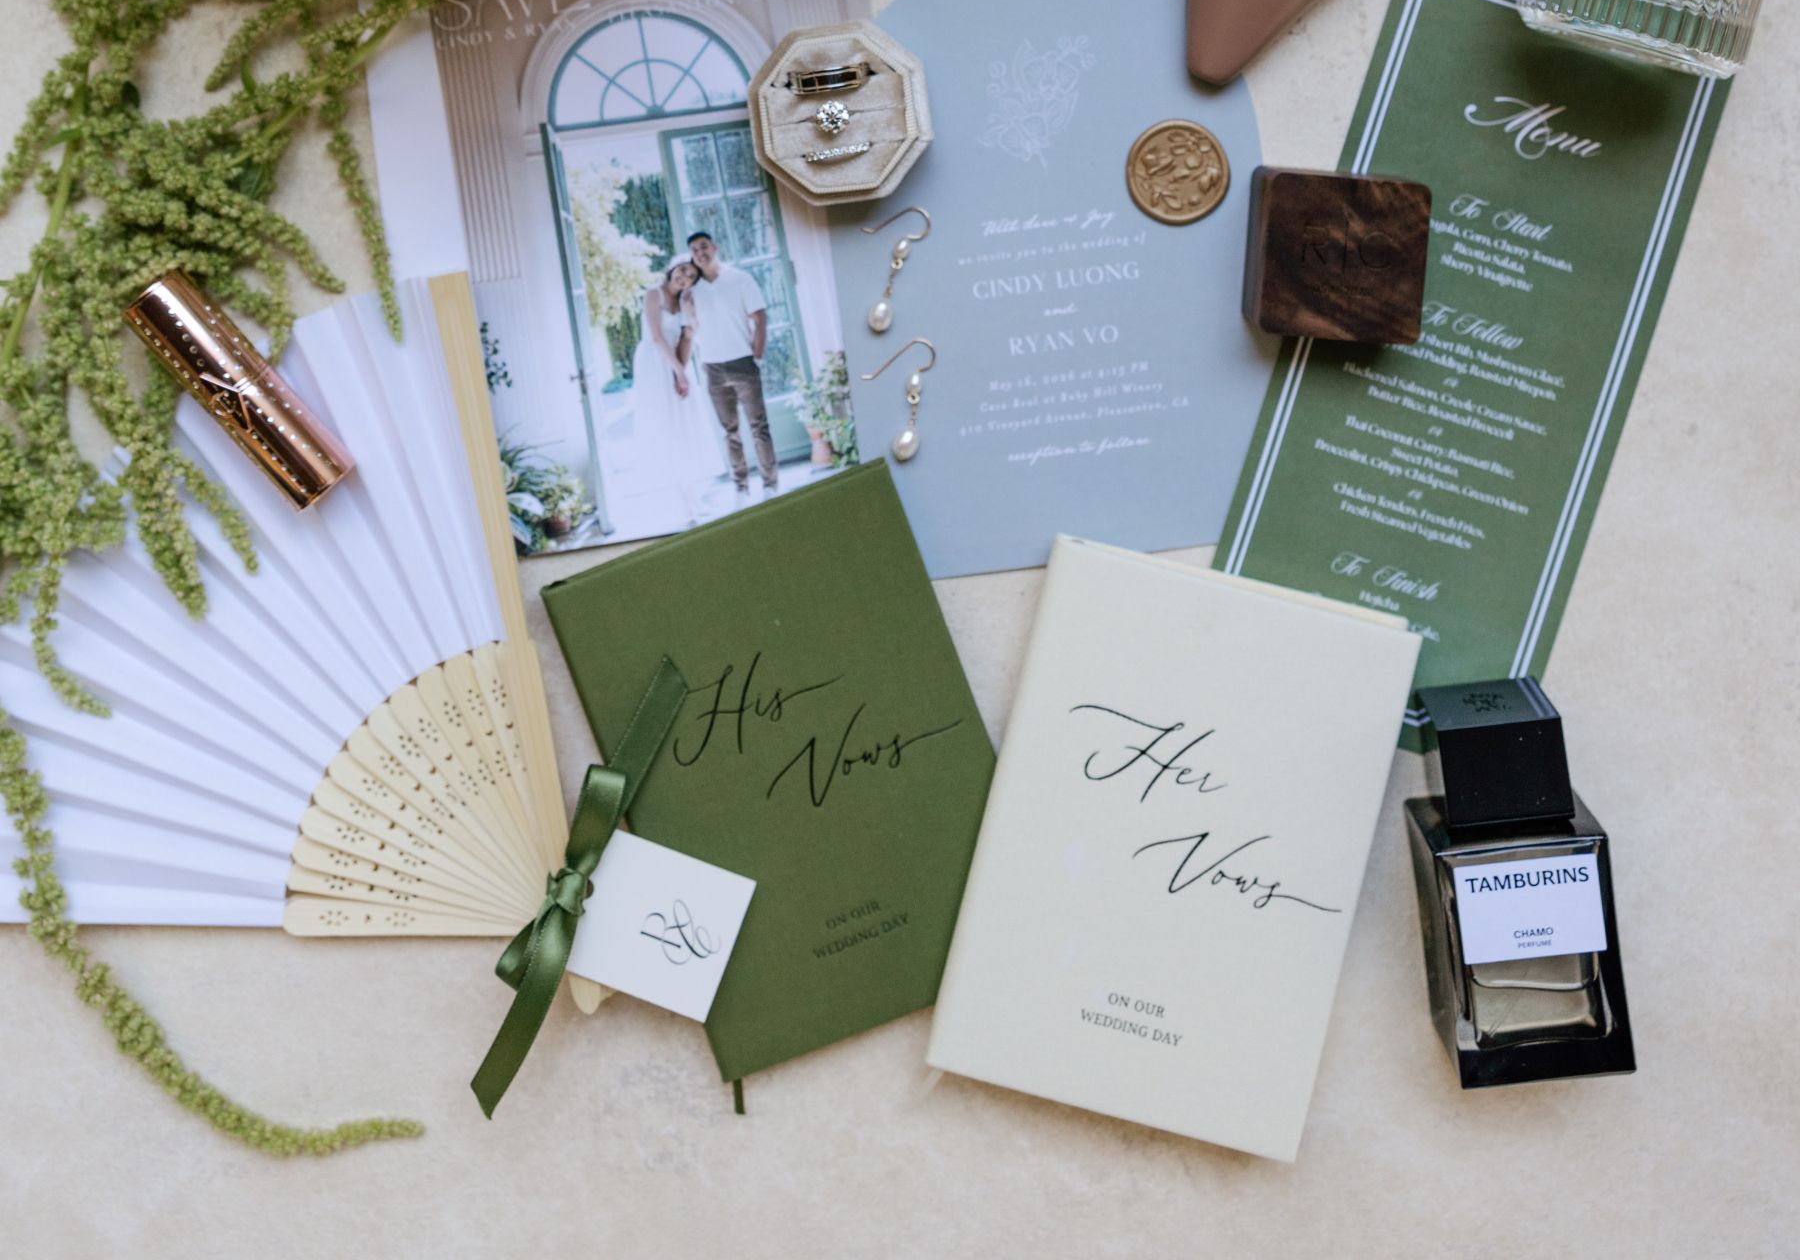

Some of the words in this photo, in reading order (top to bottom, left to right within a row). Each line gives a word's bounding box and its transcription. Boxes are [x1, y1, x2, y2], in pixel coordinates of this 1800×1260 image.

[1464, 96, 1602, 160] Menu
[972, 273, 1046, 299] CINDY
[1055, 261, 1139, 289] LUONG
[1009, 327, 1076, 357] RYAN
[1083, 323, 1120, 345] VO
[674, 652, 844, 766] His
[766, 703, 963, 807] Vows
[1069, 705, 1228, 803] Her
[1132, 831, 1342, 913] Vows
[1465, 866, 1589, 893] TAMBURINS
[825, 914, 848, 930] ON
[850, 900, 881, 919] OUR
[1513, 927, 1554, 939] CHAMO
[812, 926, 879, 958] WEDDING
[882, 912, 909, 933] DAY
[1517, 939, 1552, 948] PERFUME
[1108, 992, 1130, 1008] ON
[1134, 999, 1165, 1018] OUR
[1081, 1008, 1149, 1038] WEDDING
[1152, 1028, 1183, 1047] DAY
